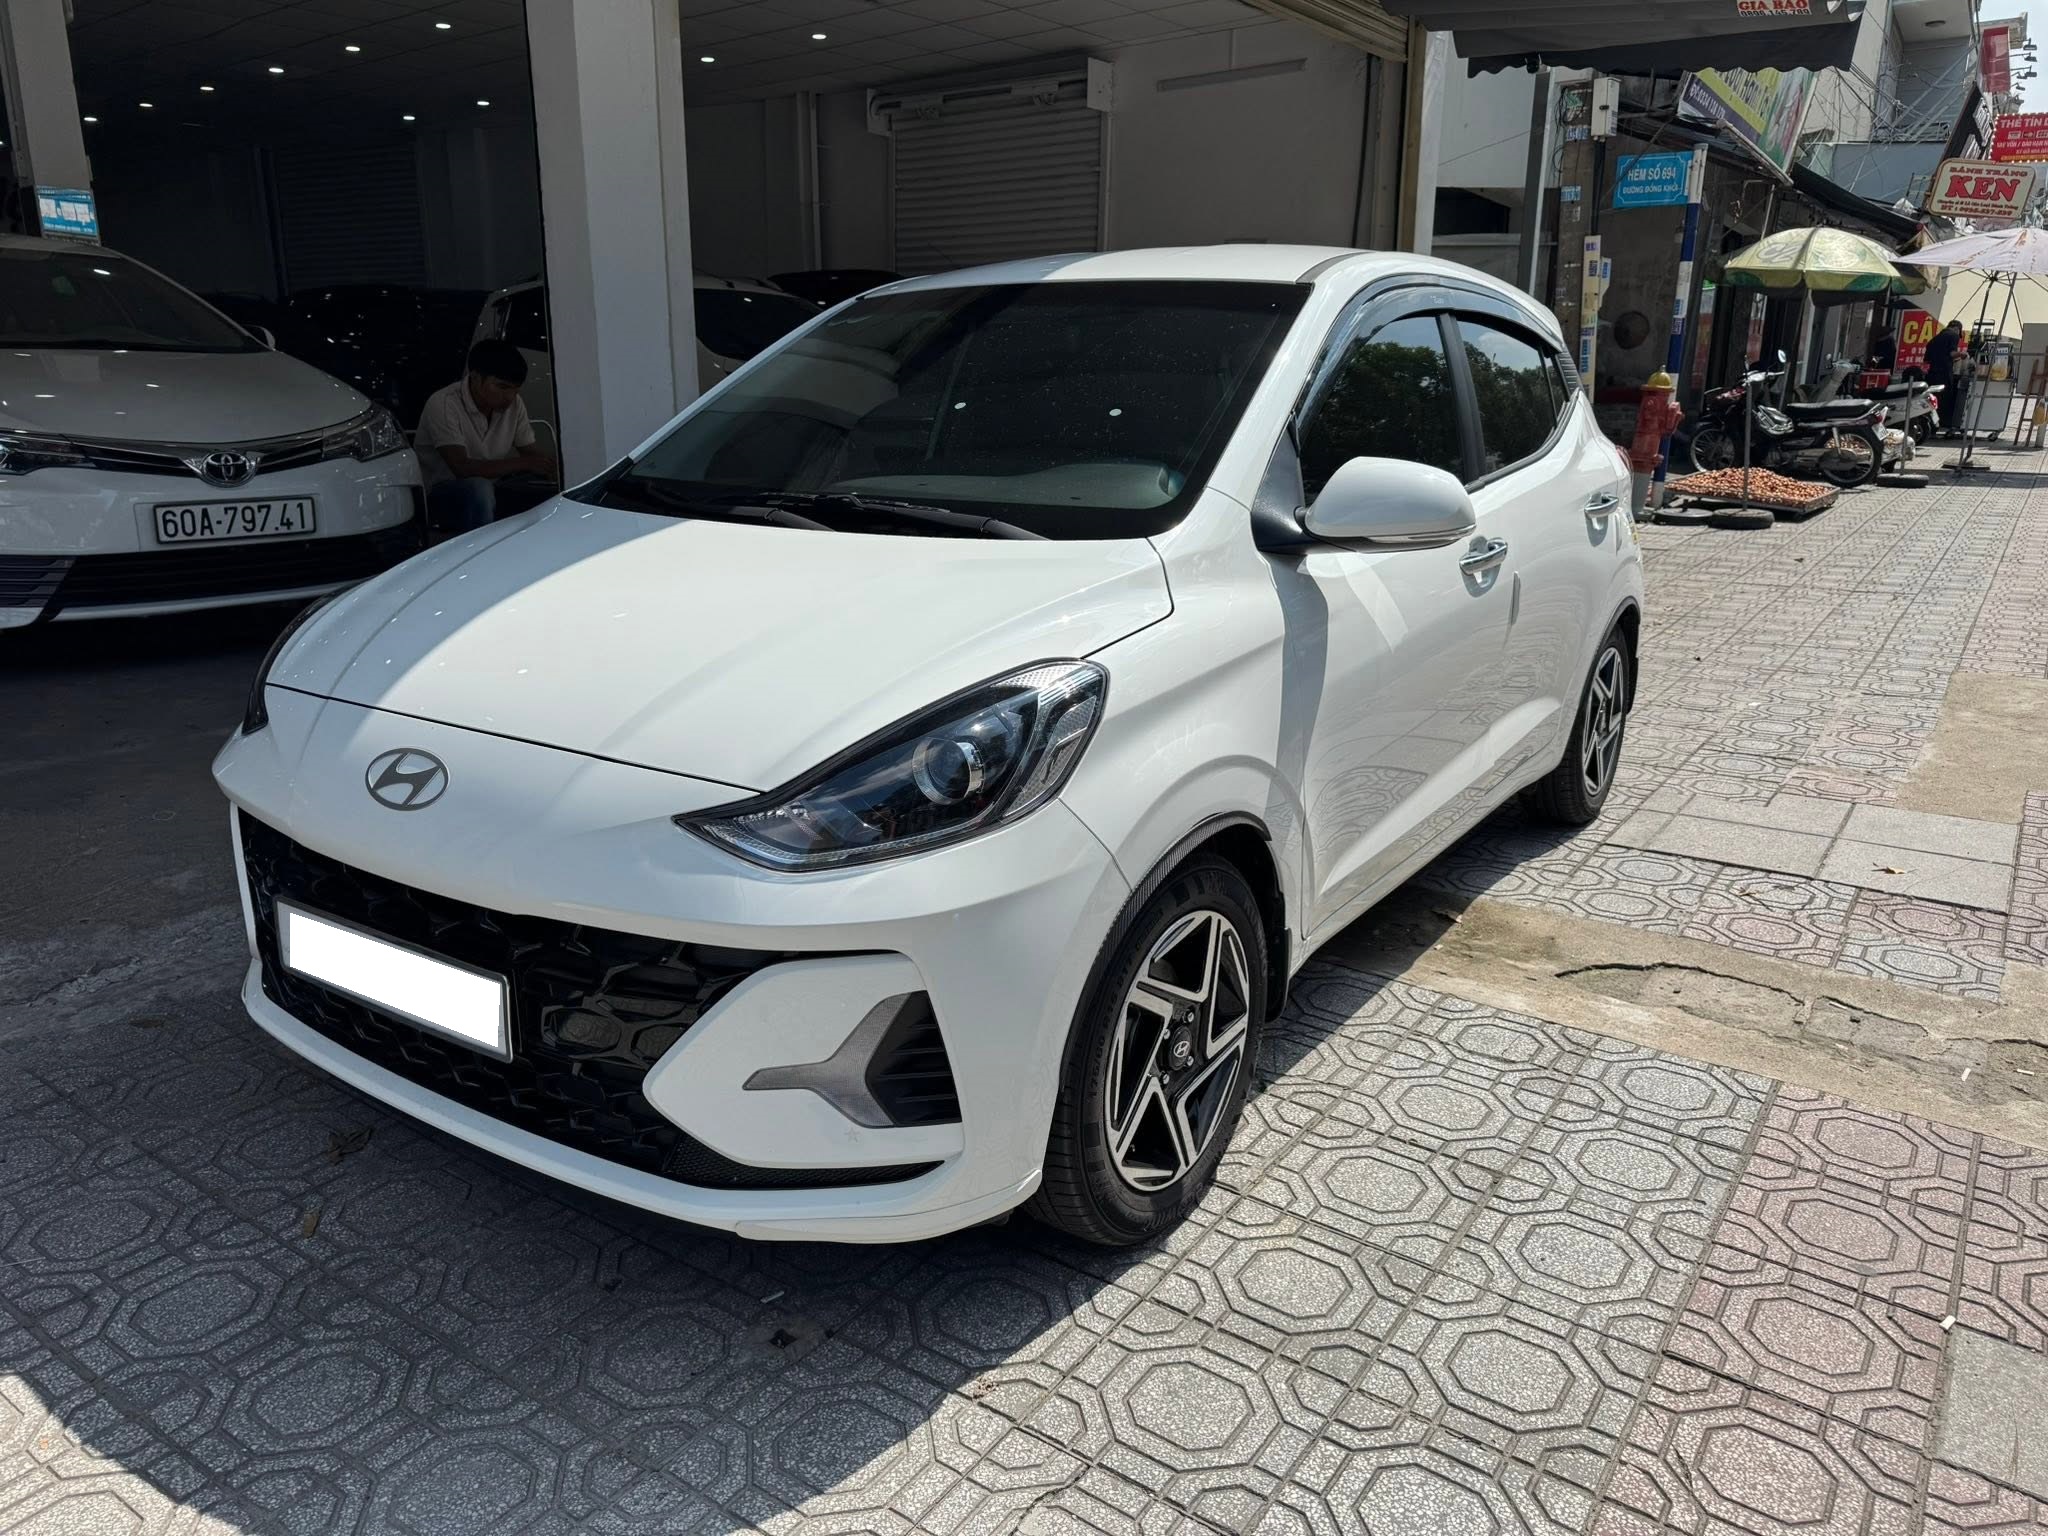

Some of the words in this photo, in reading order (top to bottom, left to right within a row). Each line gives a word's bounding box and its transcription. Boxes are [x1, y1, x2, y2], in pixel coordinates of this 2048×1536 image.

[1739, 0, 1768, 10] GIA
[2024, 115, 2043, 127] TÍN
[1628, 164, 1647, 181] HẺM
[1648, 163, 1661, 180] SỐ
[1662, 167, 1676, 180] 694
[1950, 166, 1984, 175] BÁNH
[1986, 168, 2028, 177] TRÁNG
[1945, 175, 2021, 202] KEN
[161, 502, 306, 538] 60A-797.41
